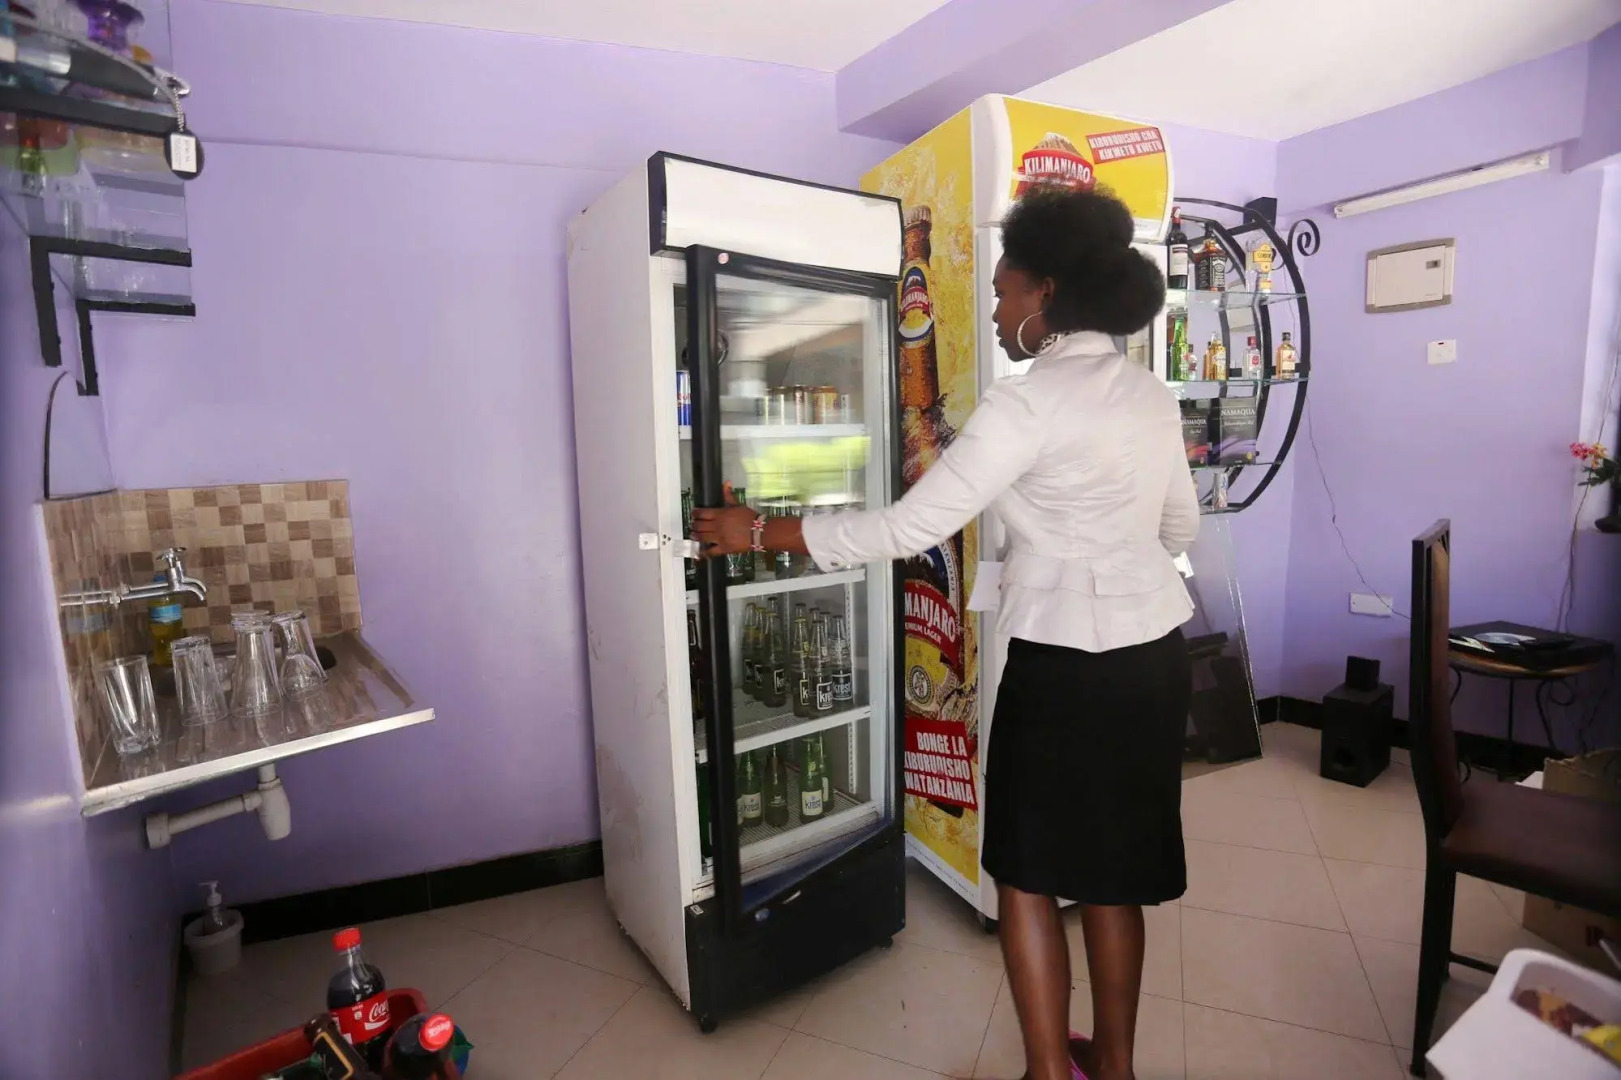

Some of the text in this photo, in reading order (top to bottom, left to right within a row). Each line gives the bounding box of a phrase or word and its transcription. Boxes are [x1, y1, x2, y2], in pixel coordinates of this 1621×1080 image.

[1140, 130, 1159, 141] CHA
[1098, 139, 1164, 161] KIKWETU KWETU
[1024, 156, 1091, 184] KILIMANJARO
[1221, 408, 1256, 416] NAMAQUA
[833, 681, 851, 694] krest
[916, 731, 968, 757] BONGE LA
[904, 771, 976, 805] WATANZANIA
